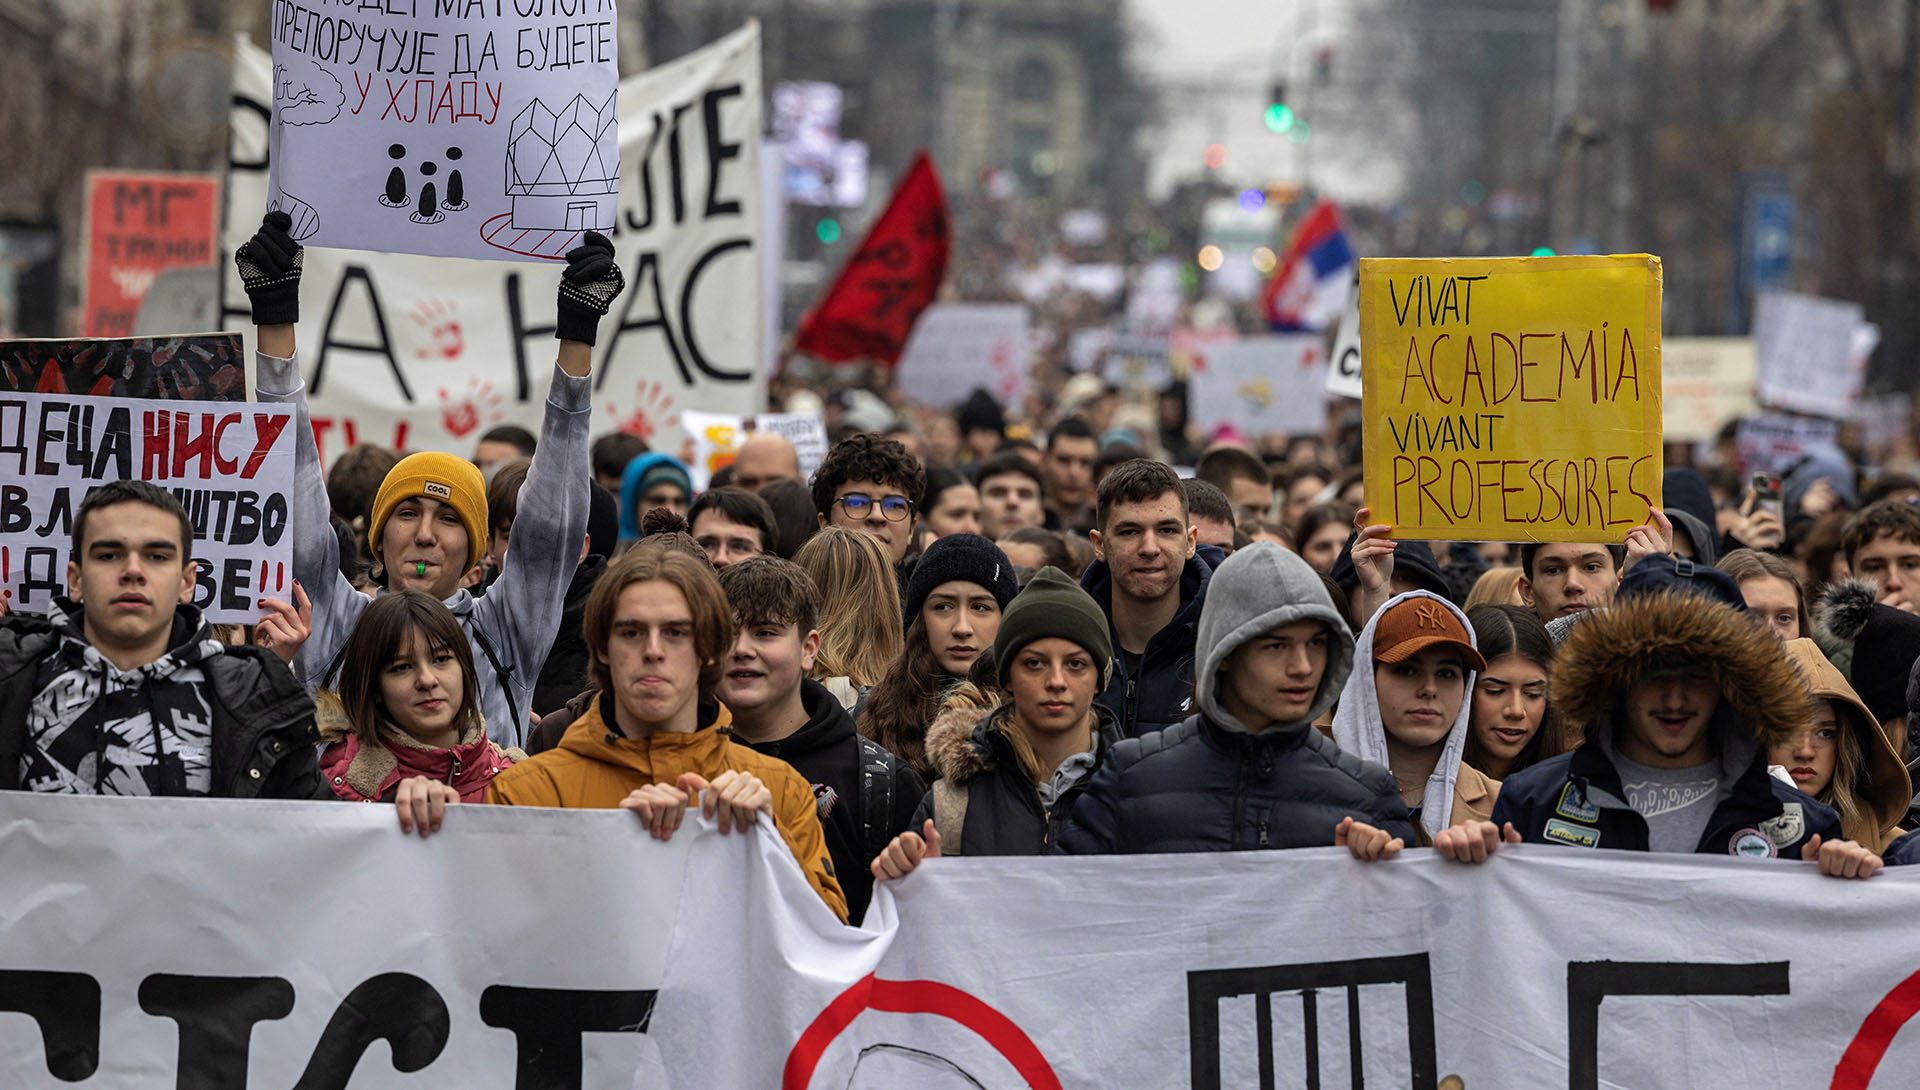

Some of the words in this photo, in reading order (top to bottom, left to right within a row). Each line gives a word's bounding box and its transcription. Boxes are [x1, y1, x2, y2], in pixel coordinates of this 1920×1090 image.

[449, 31, 499, 79] ДА
[516, 22, 611, 72] БУДЕТЕ
[350, 70, 372, 115] У
[381, 78, 502, 125] ХЛАДУ
[141, 409, 291, 481] НИСУ
[427, 484, 448, 496] COOL
[1393, 454, 1653, 531] PROFESSORES
